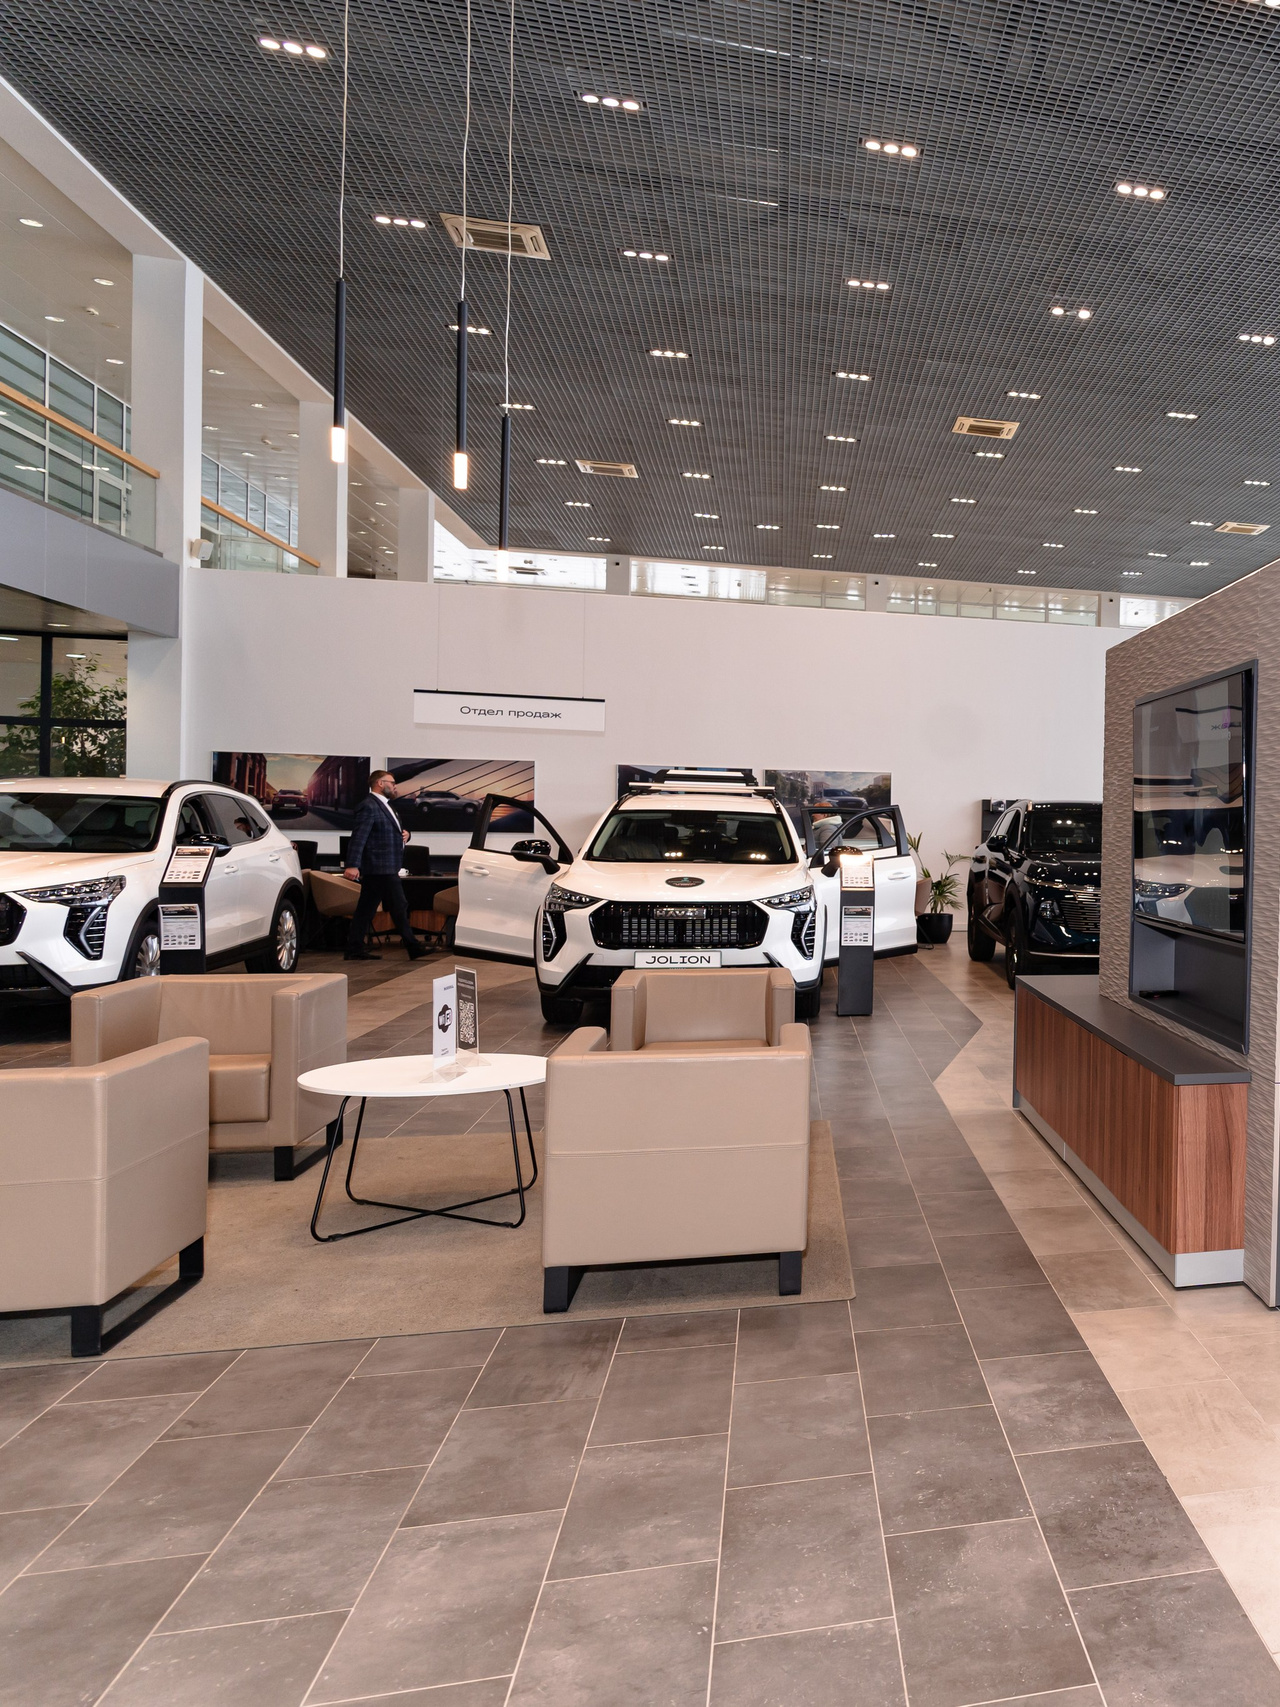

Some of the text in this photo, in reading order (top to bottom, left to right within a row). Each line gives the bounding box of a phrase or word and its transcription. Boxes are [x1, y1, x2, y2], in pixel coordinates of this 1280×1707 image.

[460, 706, 562, 719] Отдел продаж
[646, 955, 711, 964] JOLION
